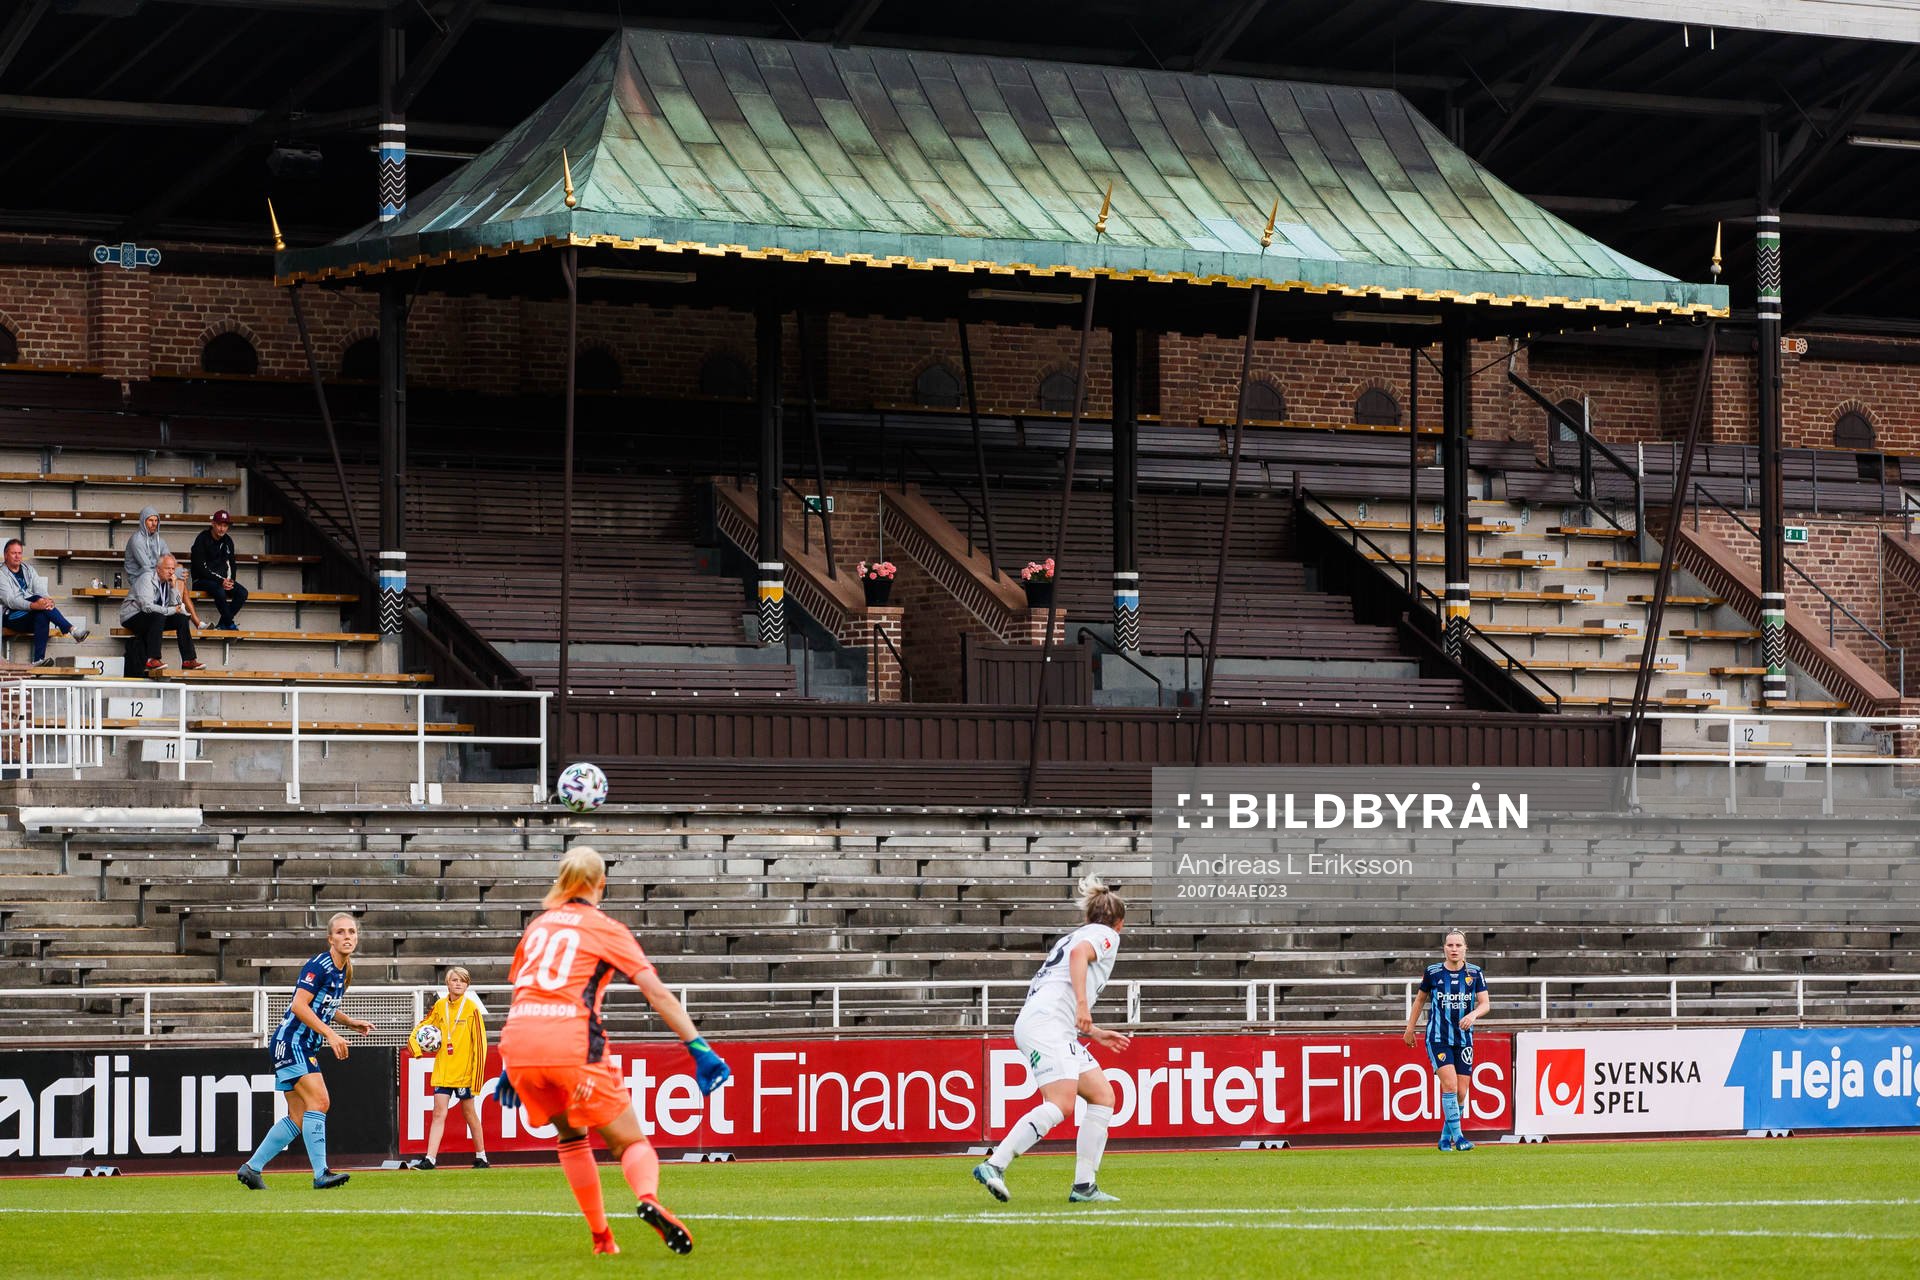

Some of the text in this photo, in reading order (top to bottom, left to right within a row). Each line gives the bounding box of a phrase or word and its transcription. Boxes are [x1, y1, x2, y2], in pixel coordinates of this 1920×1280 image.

[130, 701, 144, 717] 12
[1744, 728, 1754, 742] 12
[165, 743, 176, 758] 11
[1783, 765, 1791, 779] 11
[515, 927, 580, 991] 20
[1436, 991, 1473, 1001] Prioritet
[1441, 1000, 1468, 1009] Finans
[1594, 1061, 1701, 1085] SVENSKA
[1772, 1045, 1920, 1109] Heja di
[753, 1052, 976, 1133] Finans
[1593, 1091, 1649, 1114] SPEL
